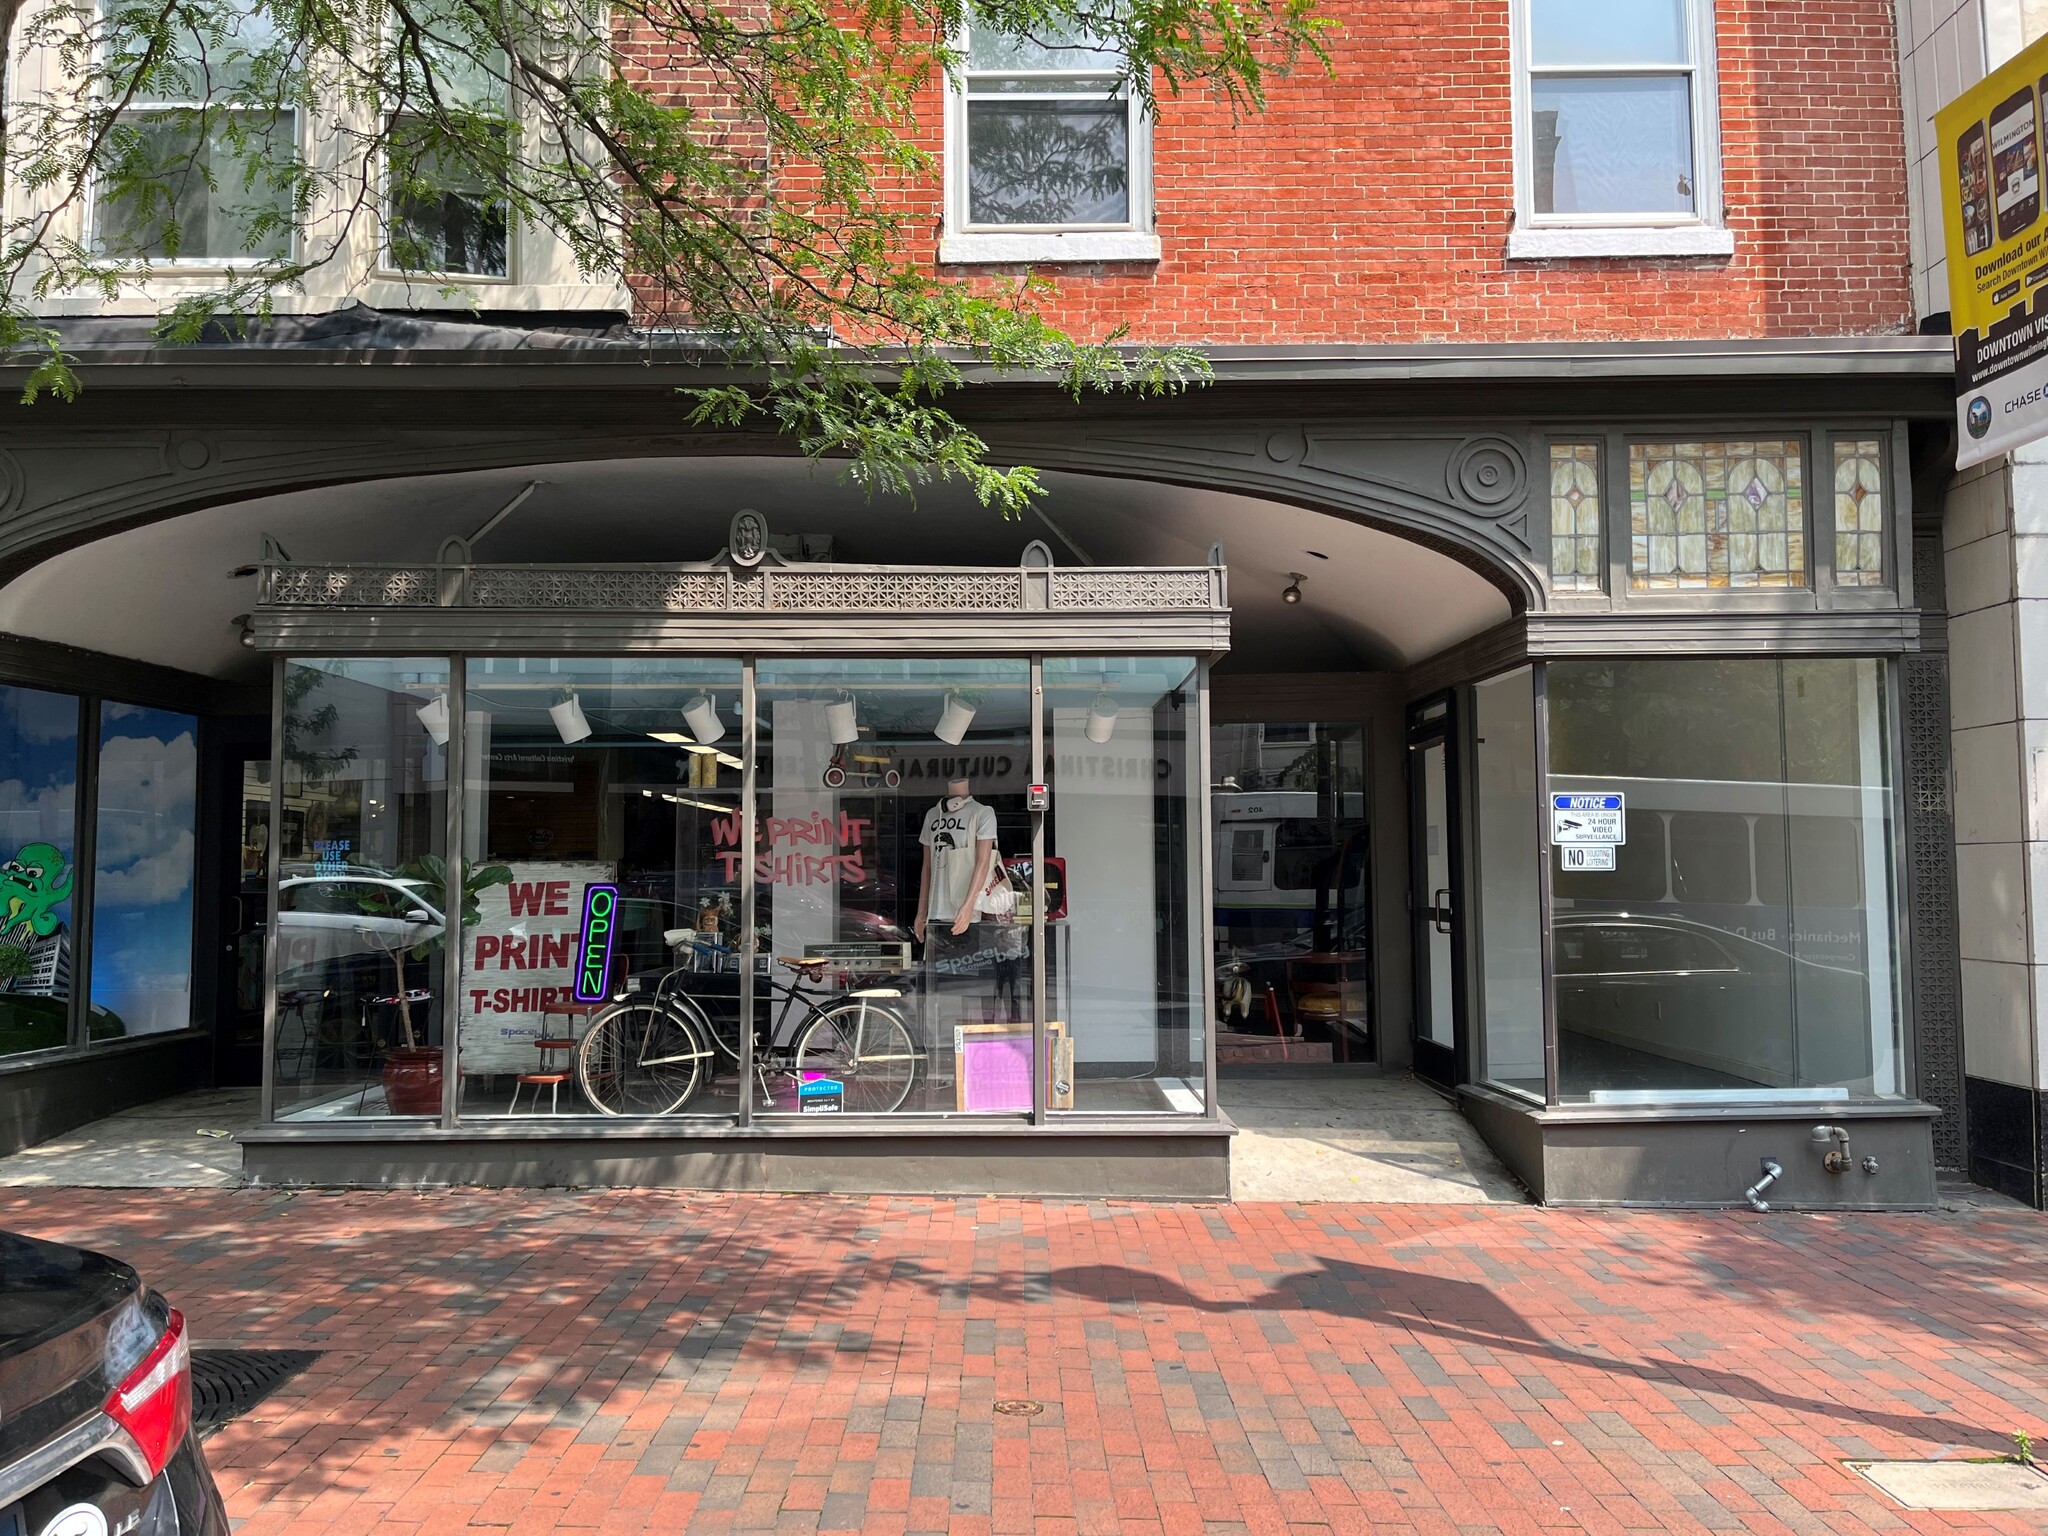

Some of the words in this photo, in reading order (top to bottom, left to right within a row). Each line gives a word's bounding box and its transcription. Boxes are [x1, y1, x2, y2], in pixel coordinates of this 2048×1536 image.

[1992, 119, 2034, 151] WILMINGTON
[1975, 242, 2023, 280] Download
[2025, 234, 2041, 252] our
[1977, 274, 2001, 294] Search
[2003, 254, 2039, 280] Downtown
[1977, 322, 2033, 364] DOWNTOWN
[2004, 388, 2041, 413] CHASE
[1569, 797, 1607, 809] NOTICE
[930, 817, 966, 832] COOL
[1587, 818, 1596, 826] 24
[1597, 818, 1617, 826] HOUR
[1592, 826, 1613, 834] VIDEO
[313, 839, 351, 851] PLEASE
[322, 850, 341, 861] USE
[1568, 849, 1585, 866] NO
[314, 861, 349, 871] OTHER
[508, 880, 571, 917] WE
[583, 892, 612, 994] OPEN
